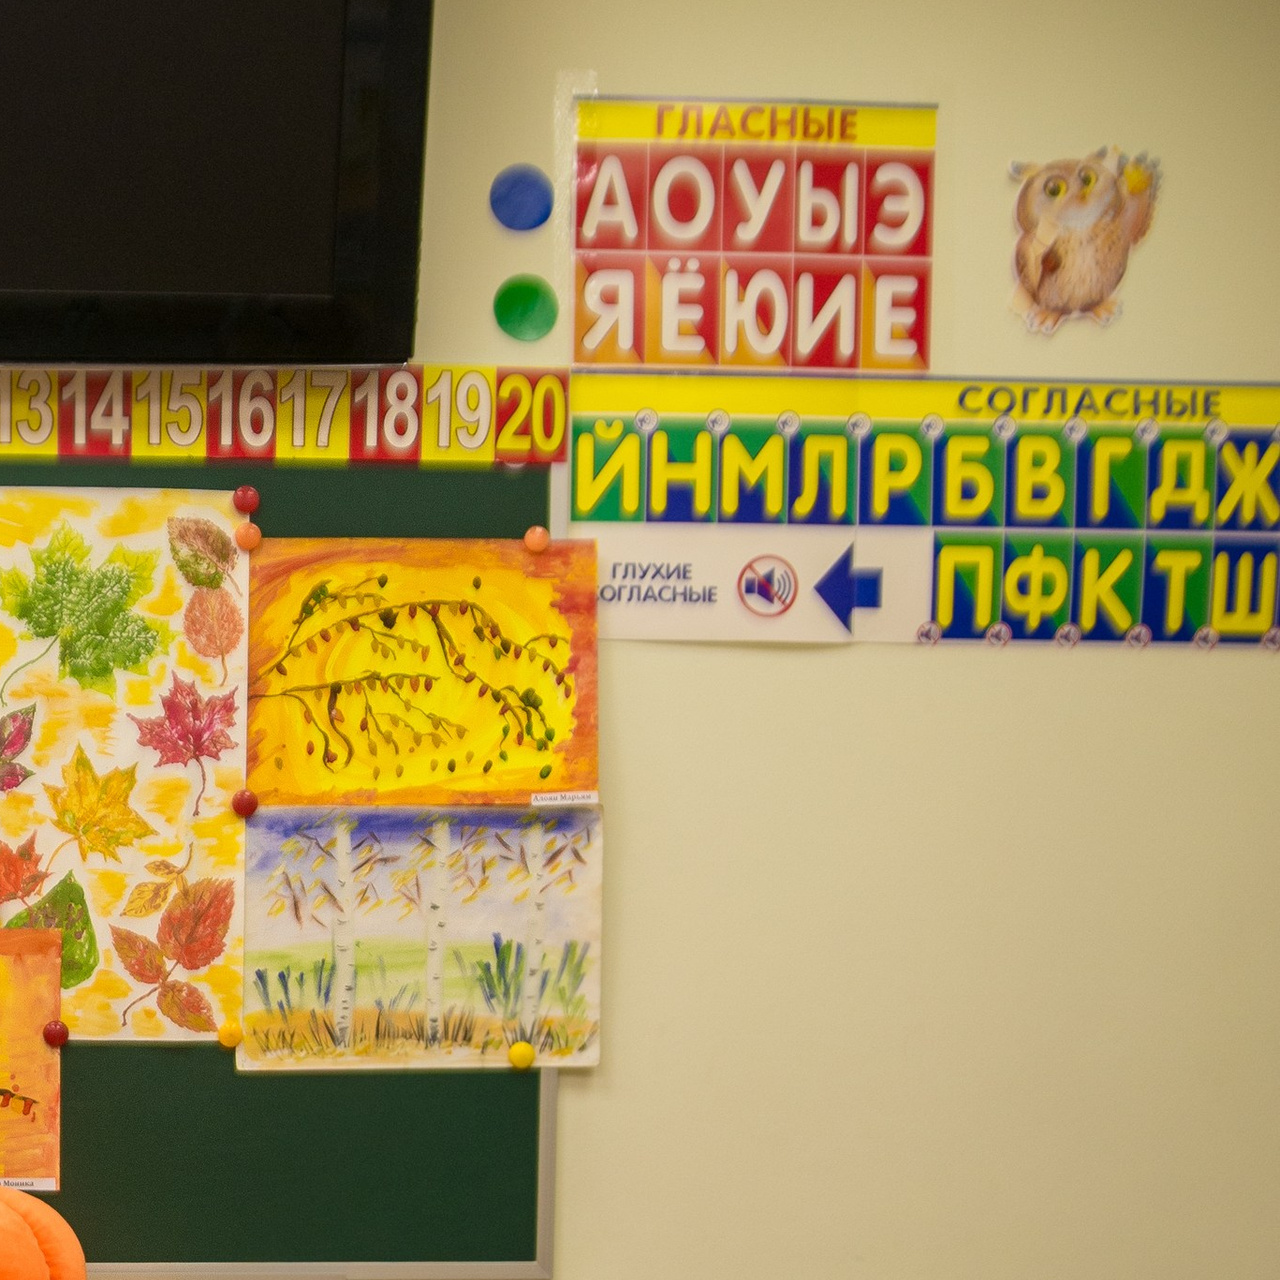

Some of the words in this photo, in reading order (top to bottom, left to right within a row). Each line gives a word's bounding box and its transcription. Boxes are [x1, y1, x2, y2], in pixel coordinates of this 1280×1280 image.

[654, 103, 858, 142] ГЛАСНЫЕ
[60, 371, 127, 446] 14
[137, 369, 203, 447] 15
[209, 370, 274, 447] 16
[280, 370, 347, 447] 17
[354, 370, 418, 448] 18
[426, 370, 492, 448] 19
[498, 374, 563, 452] 20
[957, 384, 1222, 418] СОГЛАСНЫЕ
[612, 562, 692, 580] ГЛУХИЕ
[596, 584, 718, 603] ОГЛАСНЫЕ
